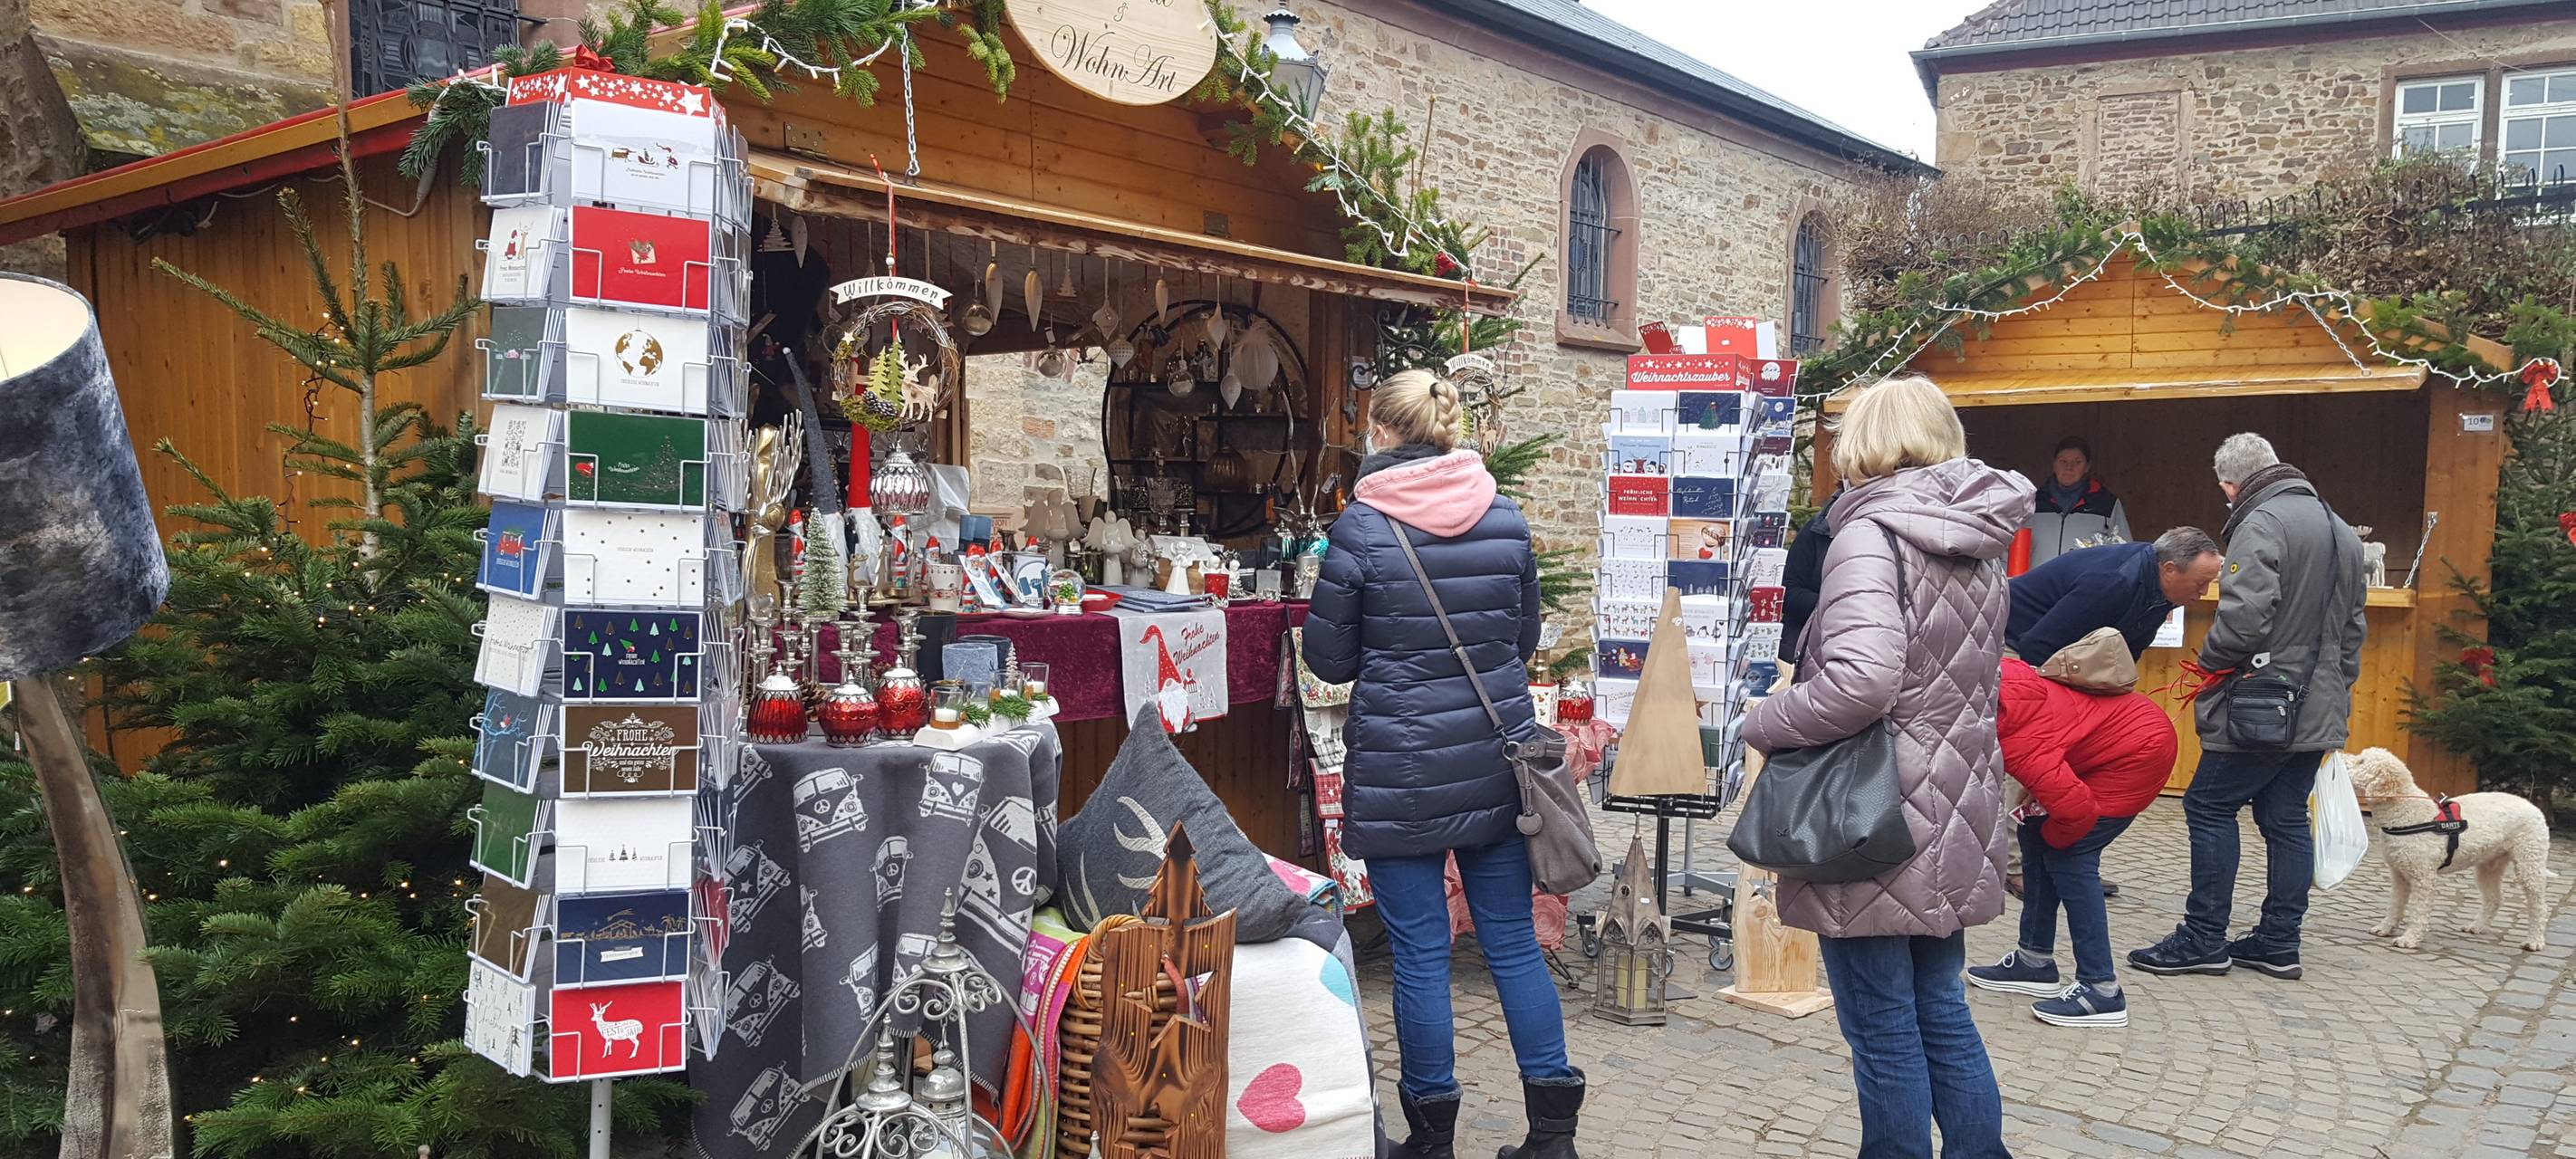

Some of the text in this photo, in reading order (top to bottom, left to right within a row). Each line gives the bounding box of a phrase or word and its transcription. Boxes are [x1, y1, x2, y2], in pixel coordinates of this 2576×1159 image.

[843, 278, 939, 300] Willkommen
[1630, 369, 1731, 384] Weihnachtszauber
[2469, 417, 2479, 426] 10
[1180, 622, 1205, 647] Frohe
[1172, 631, 1220, 666] Weihnachten
[617, 729, 648, 742] FROHE
[582, 740, 679, 757] Weihnachten
